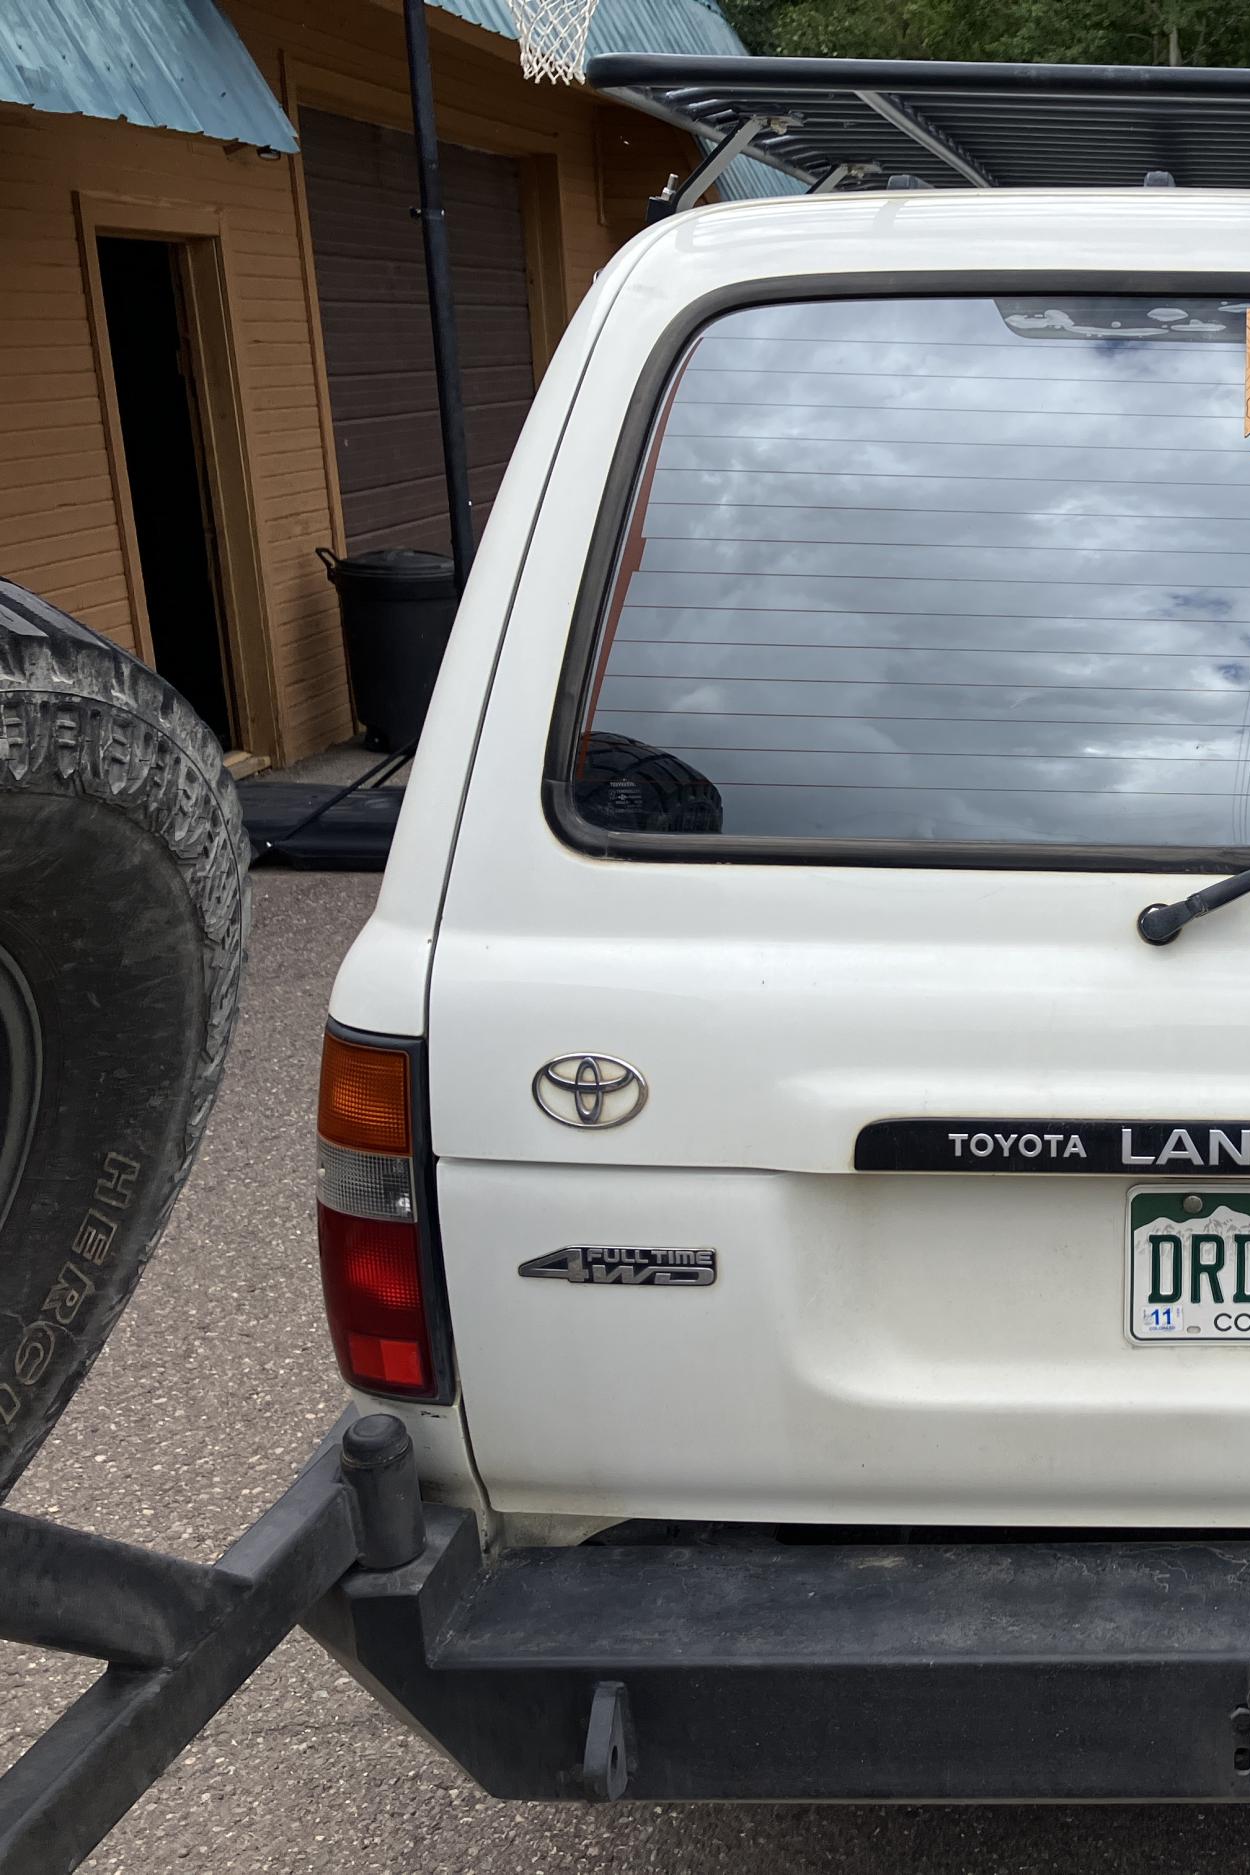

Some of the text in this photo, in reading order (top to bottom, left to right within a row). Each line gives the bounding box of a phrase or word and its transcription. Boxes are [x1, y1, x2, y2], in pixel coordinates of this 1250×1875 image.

[947, 1132, 1088, 1159] TOYOTA
[518, 1247, 715, 1286] 4WD
[586, 1248, 713, 1265] FULL TIME
[1151, 1307, 1171, 1326] 11
